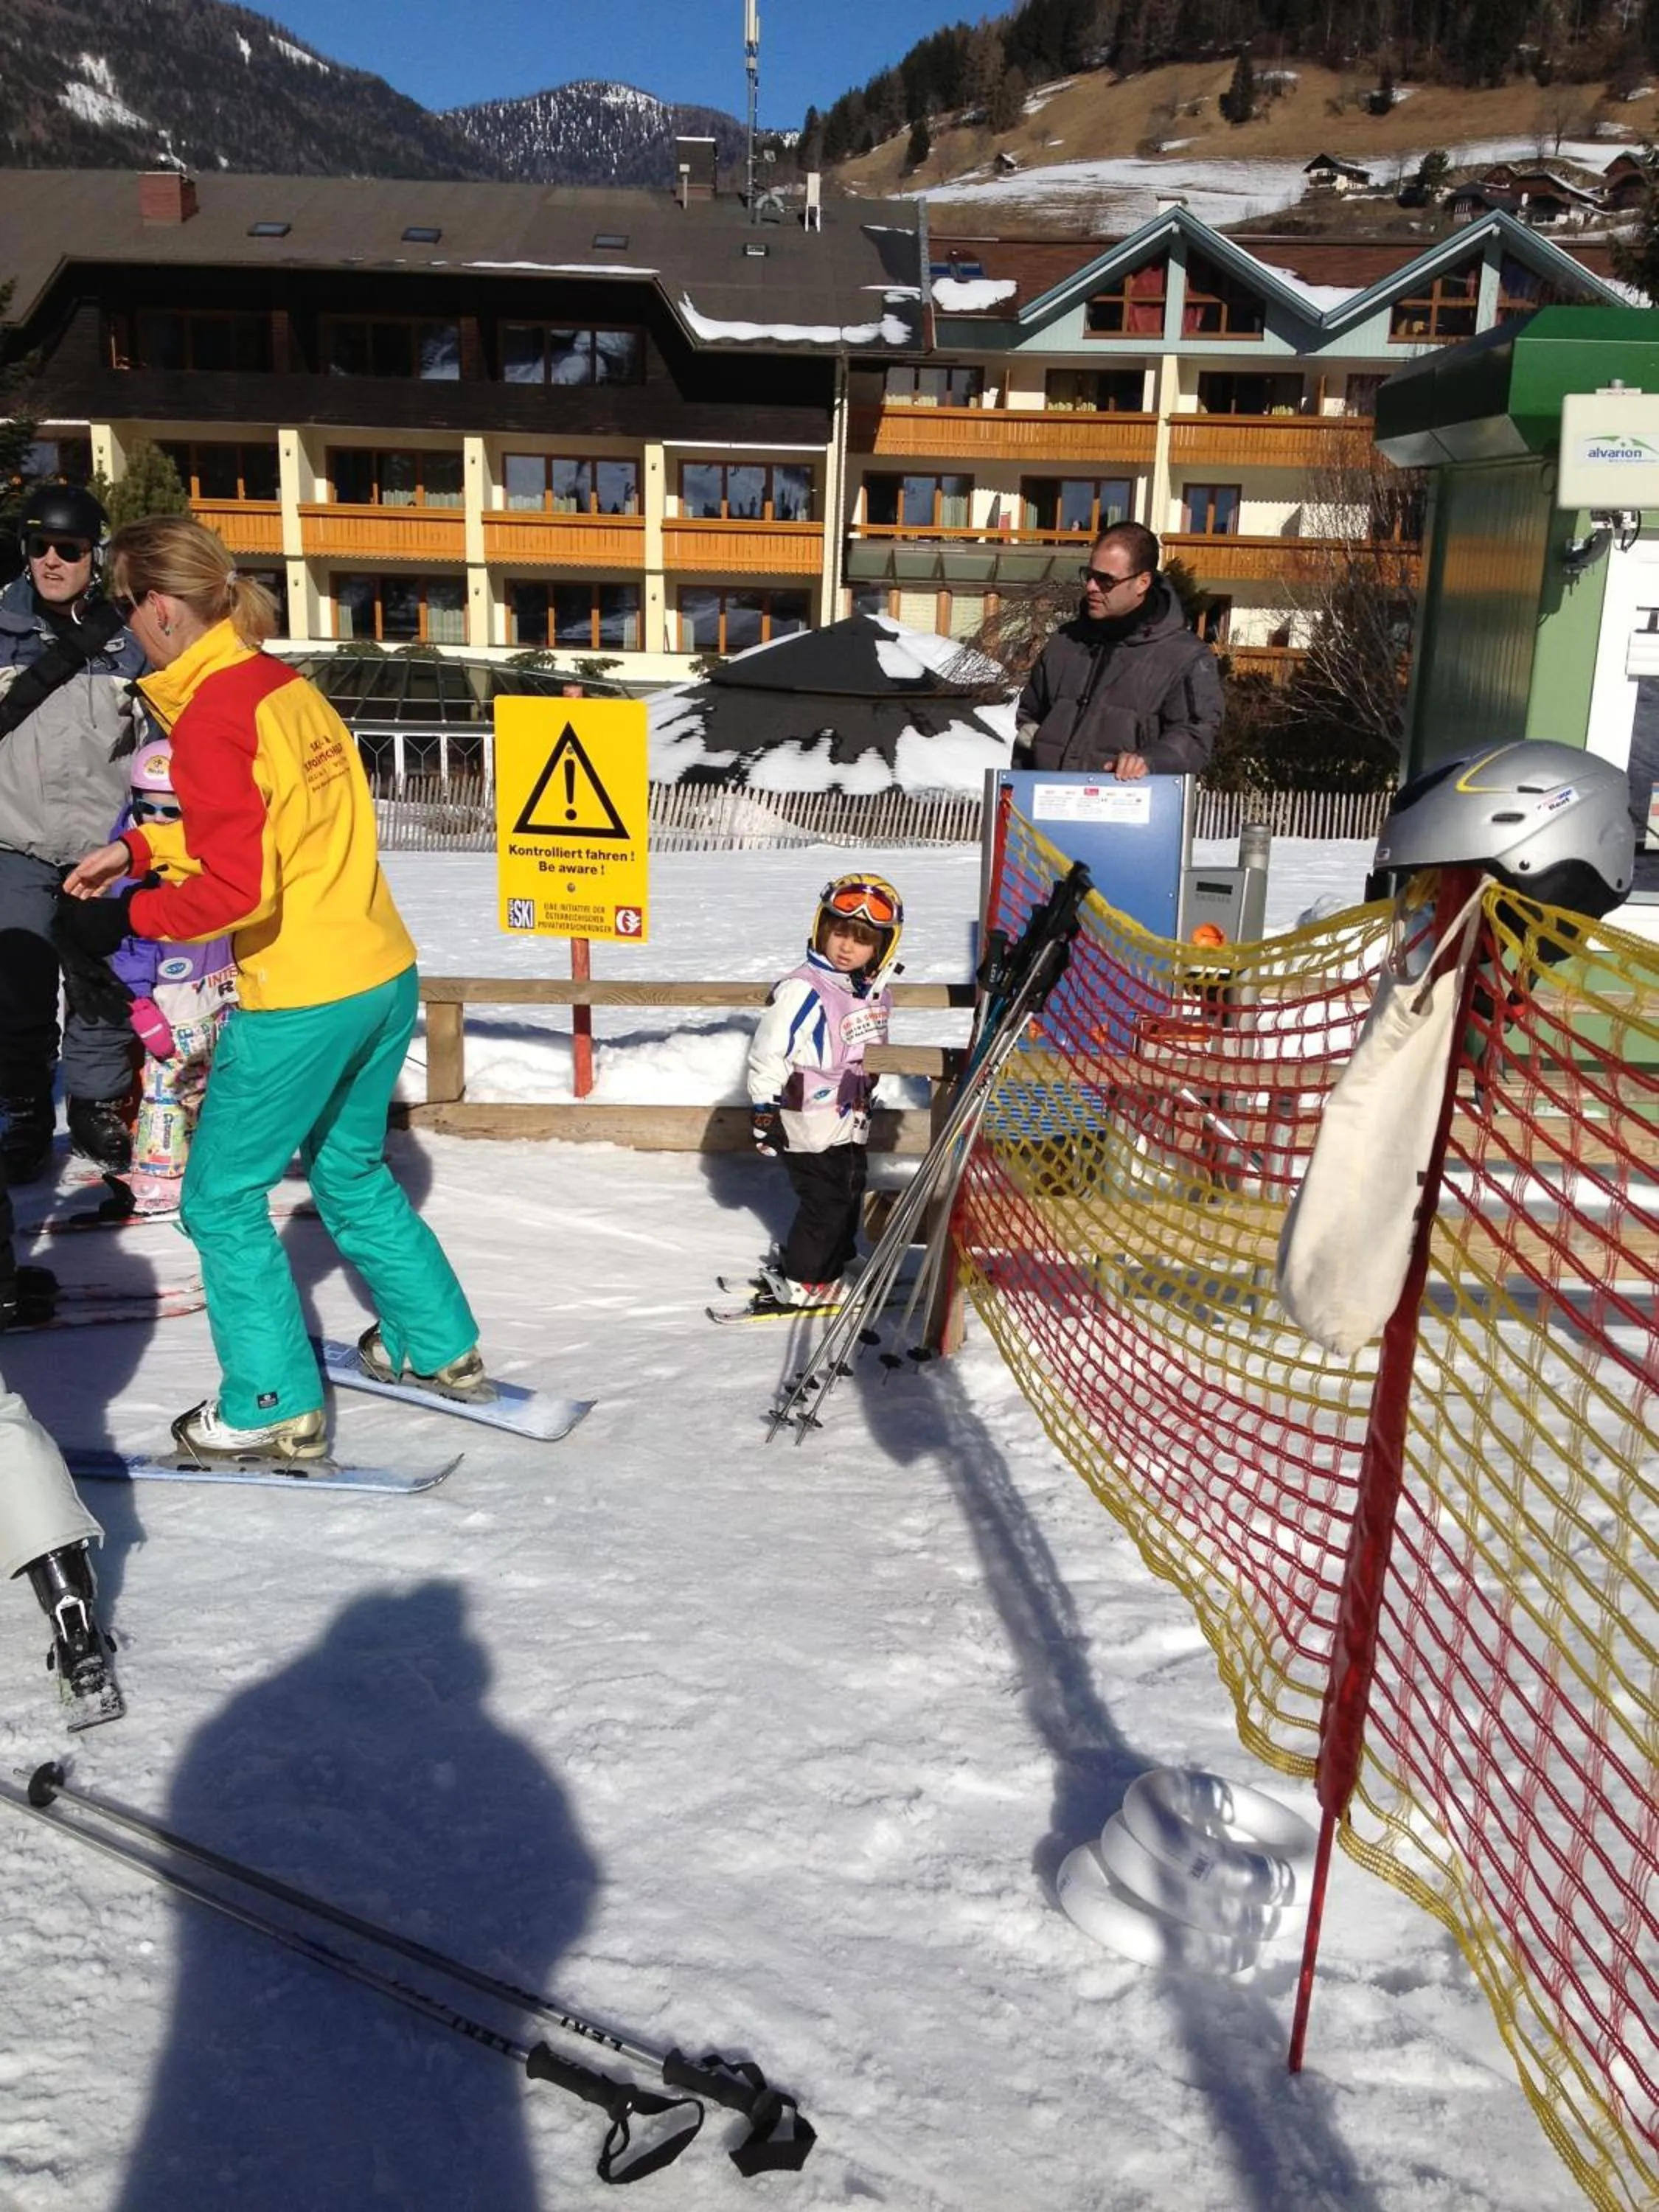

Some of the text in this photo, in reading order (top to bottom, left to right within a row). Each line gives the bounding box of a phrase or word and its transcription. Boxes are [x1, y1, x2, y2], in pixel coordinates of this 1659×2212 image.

[1587, 443, 1642, 458] alvarion
[509, 844, 582, 859] Kontrolliert
[585, 849, 627, 861] fahren
[539, 860, 554, 872] Be
[559, 864, 597, 874] aware
[514, 900, 532, 927] SKI
[560, 2017, 622, 2052] LEKI
